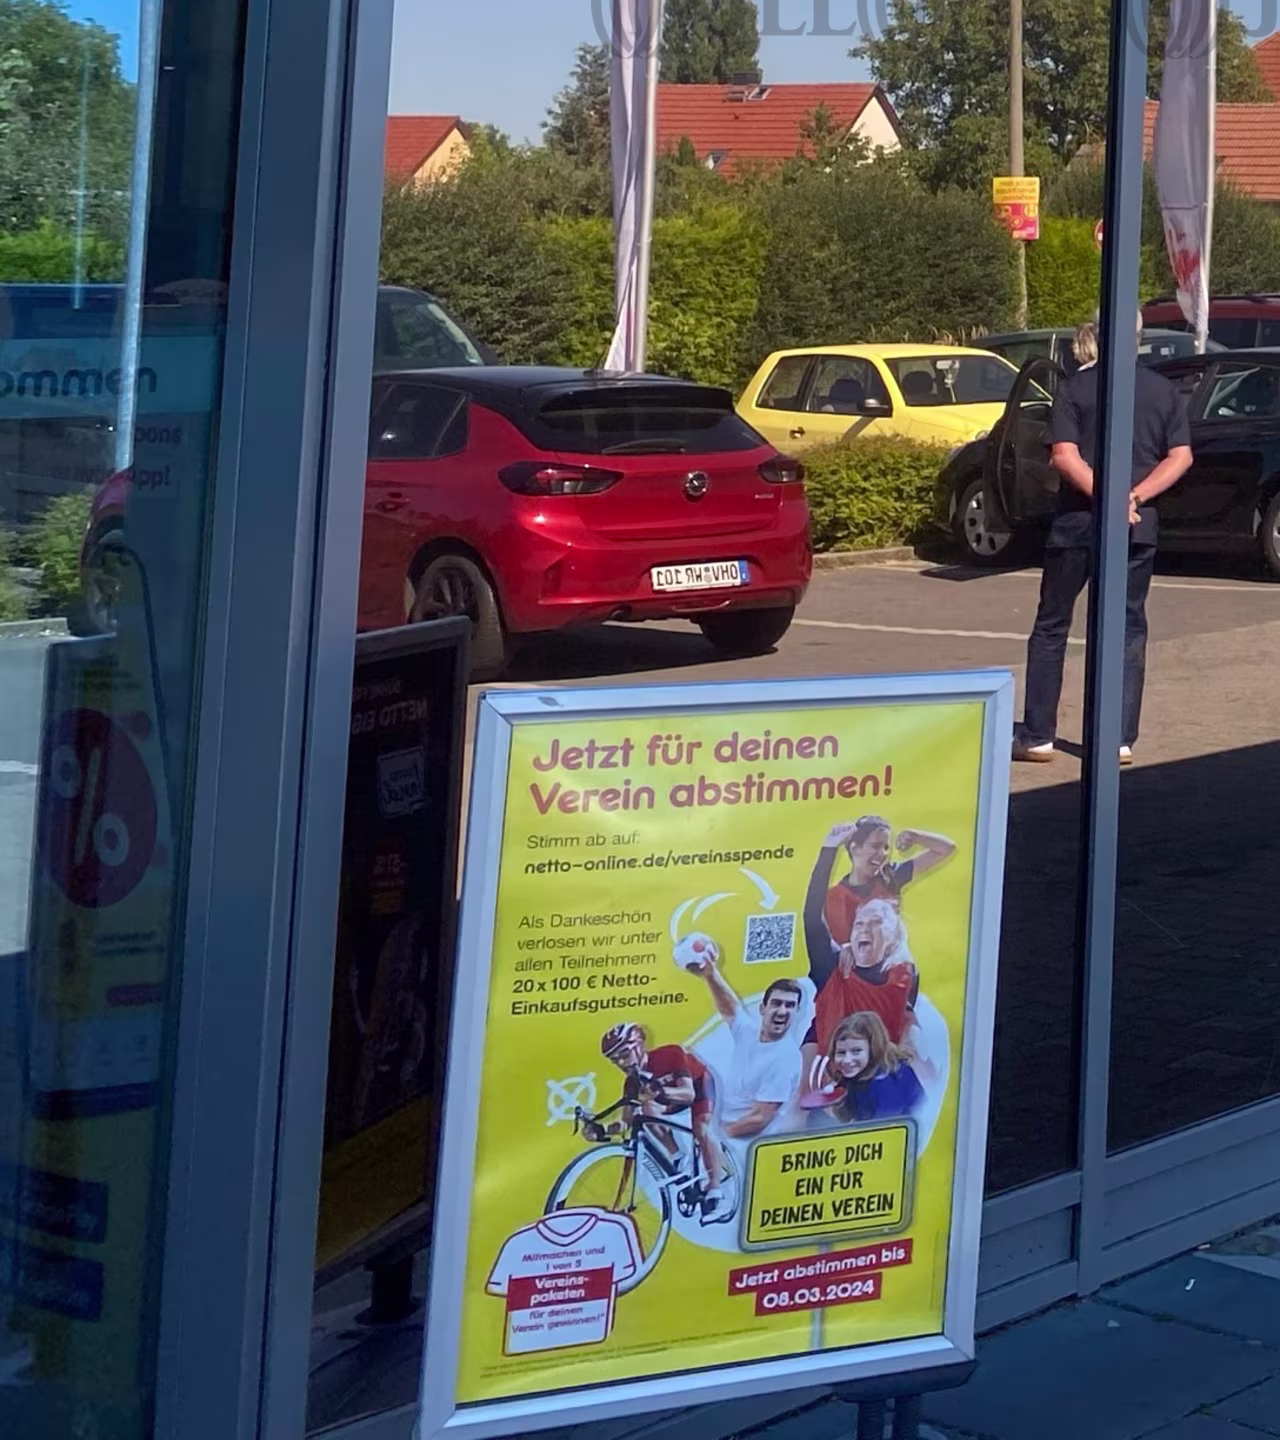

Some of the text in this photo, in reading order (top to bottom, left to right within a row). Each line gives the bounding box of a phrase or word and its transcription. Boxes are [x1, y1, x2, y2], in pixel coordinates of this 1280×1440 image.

[532, 731, 839, 772] Jetzt für deinen
[530, 765, 893, 815] Verein abstimmen!
[527, 830, 640, 849] Stimm ab auf:
[524, 845, 794, 874] netto-online.de/vereinsspende
[518, 911, 652, 929] Als Dankeschön
[517, 930, 663, 951] verlosen wir unter
[514, 952, 657, 973] allen Teilnehmern
[512, 973, 658, 993] 20 x 100 € Netto-
[511, 990, 689, 1015] Einkaufsgutscheine.
[780, 1141, 883, 1173] BRING DICH
[795, 1169, 864, 1197] EIN FÜR
[760, 1193, 895, 1228] DEINEN VEREIN
[585, 1245, 606, 1255] und
[735, 1246, 906, 1288] Jetzt abstimmen bis
[535, 1274, 590, 1289] Vereins-
[530, 1289, 586, 1307] paketen
[762, 1279, 875, 1309] 08.03.2024
[529, 1306, 583, 1320] für deinen
[512, 1322, 545, 1333] Verein
